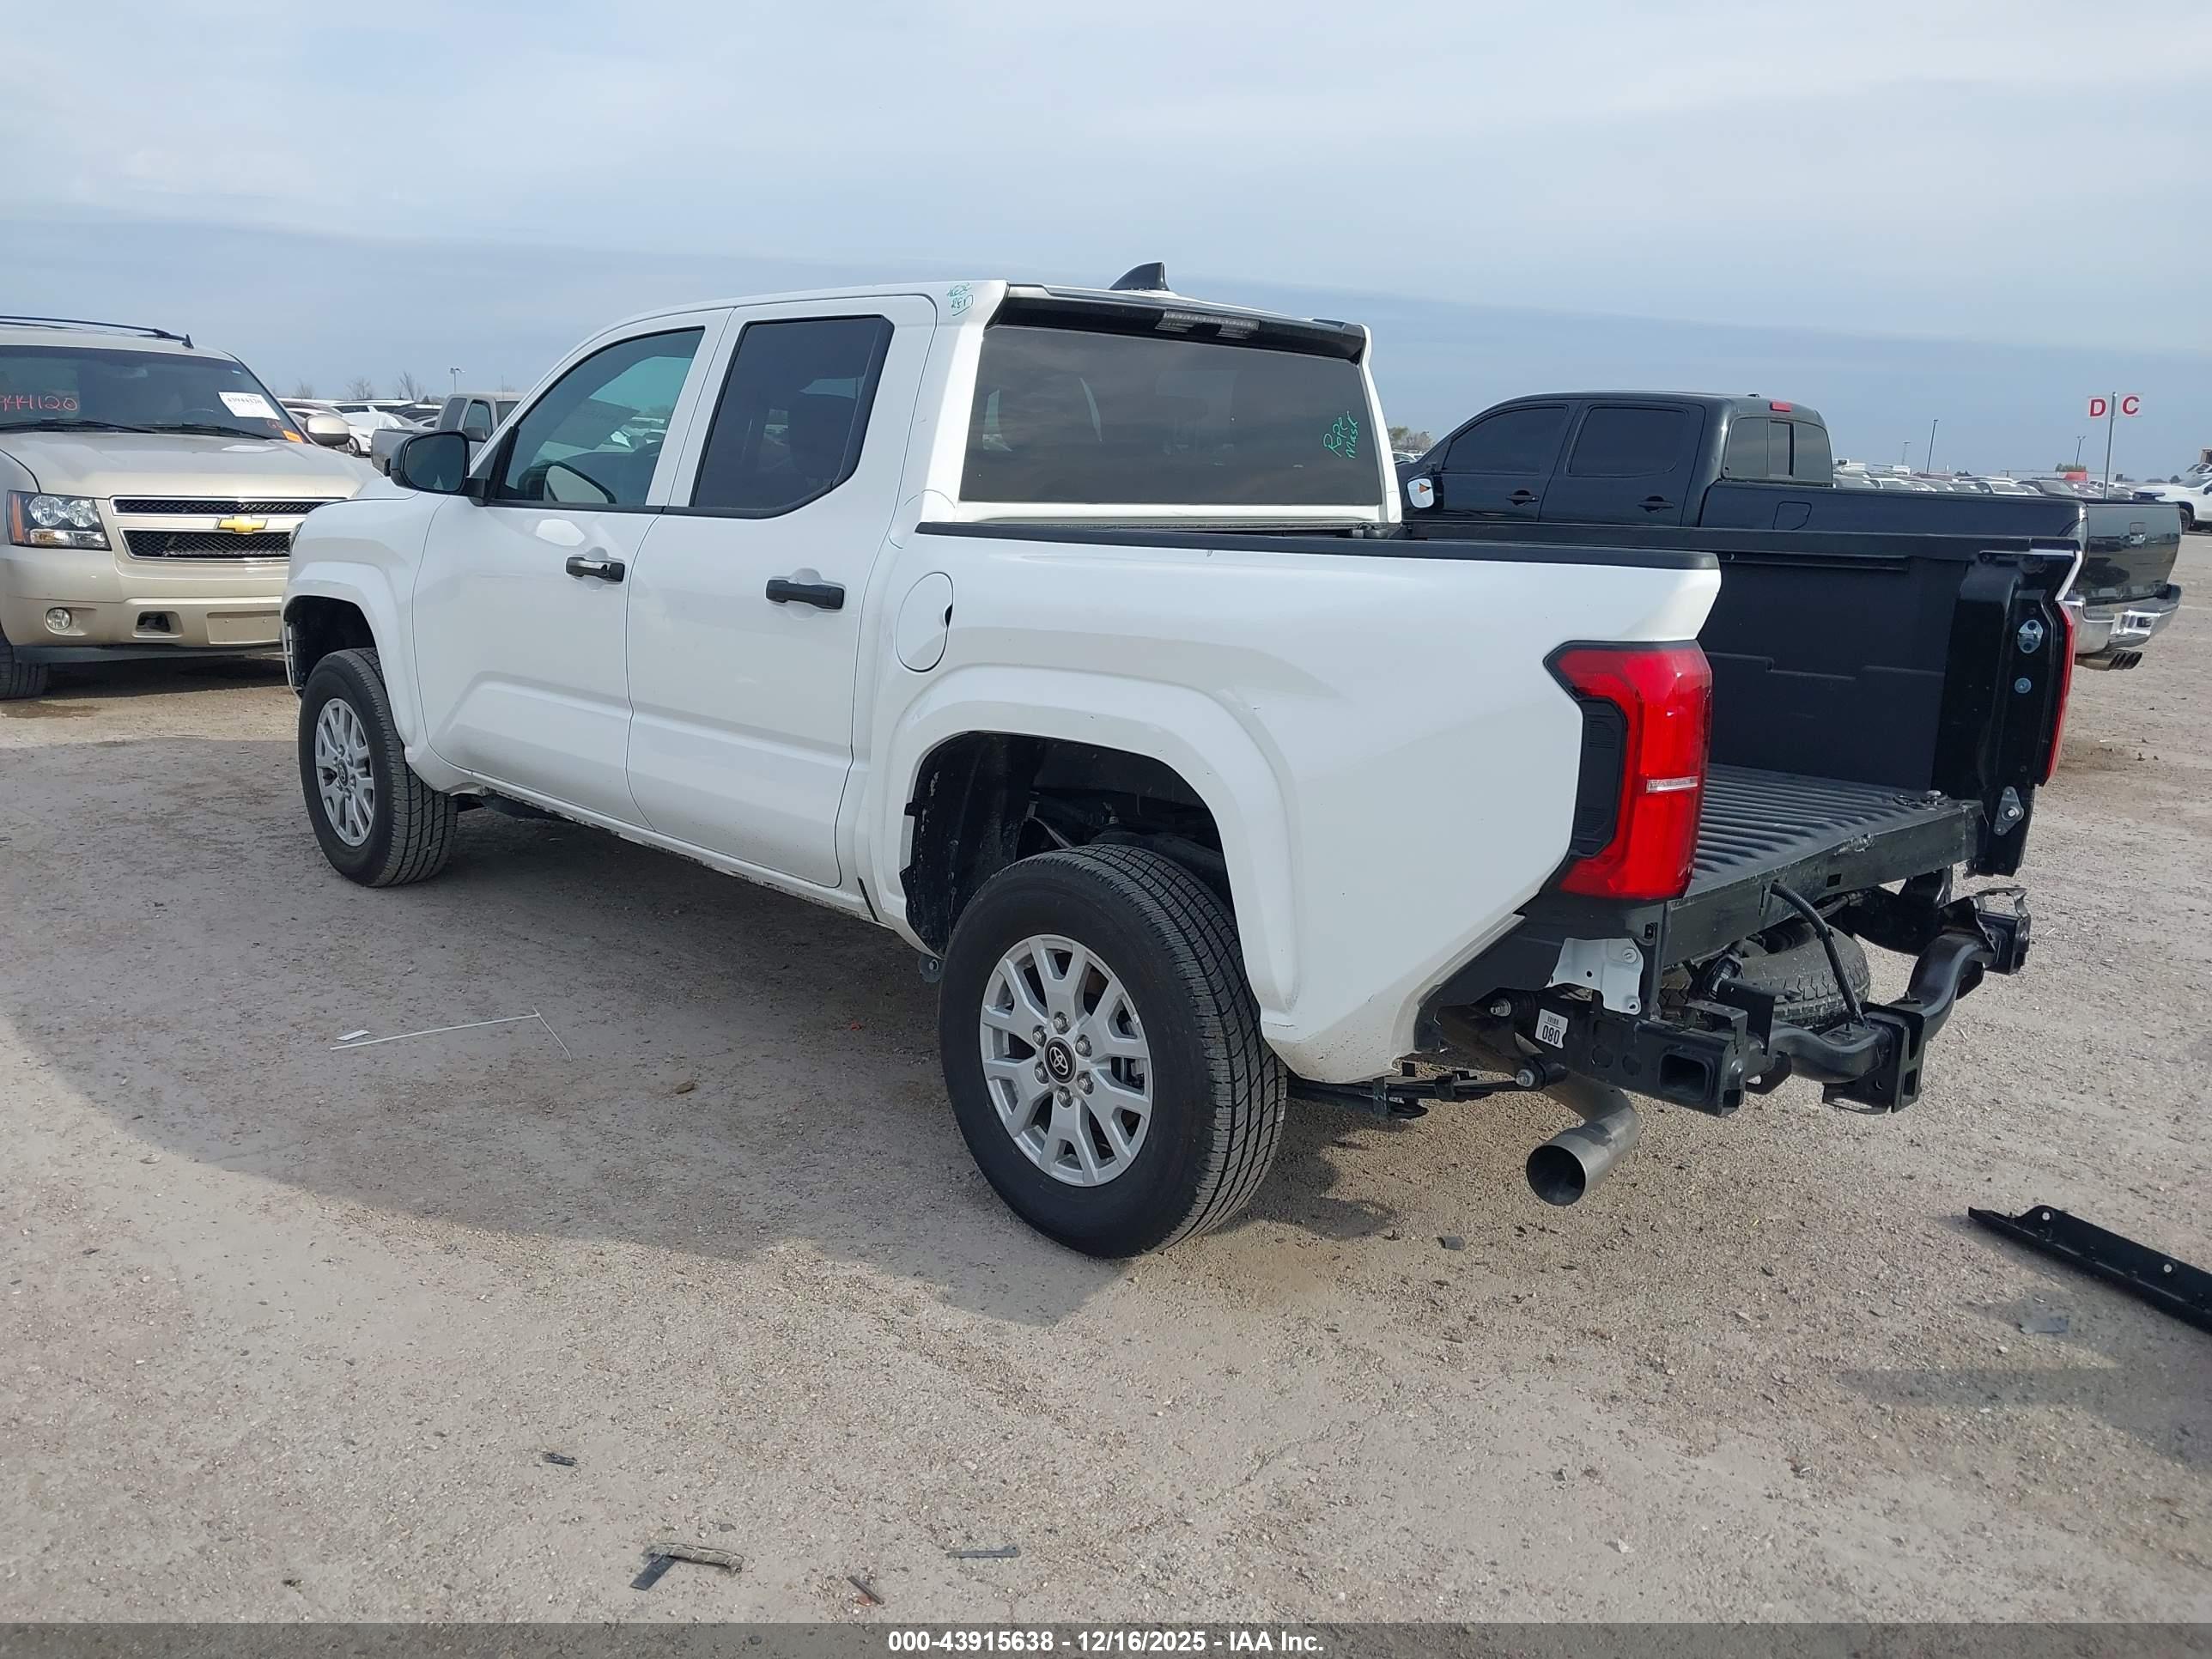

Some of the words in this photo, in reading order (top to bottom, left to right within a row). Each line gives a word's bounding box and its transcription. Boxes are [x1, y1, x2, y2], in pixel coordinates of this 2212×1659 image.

[2089, 398, 2106, 417] D
[2122, 396, 2140, 415] C
[1542, 1025, 1560, 1045] 080
